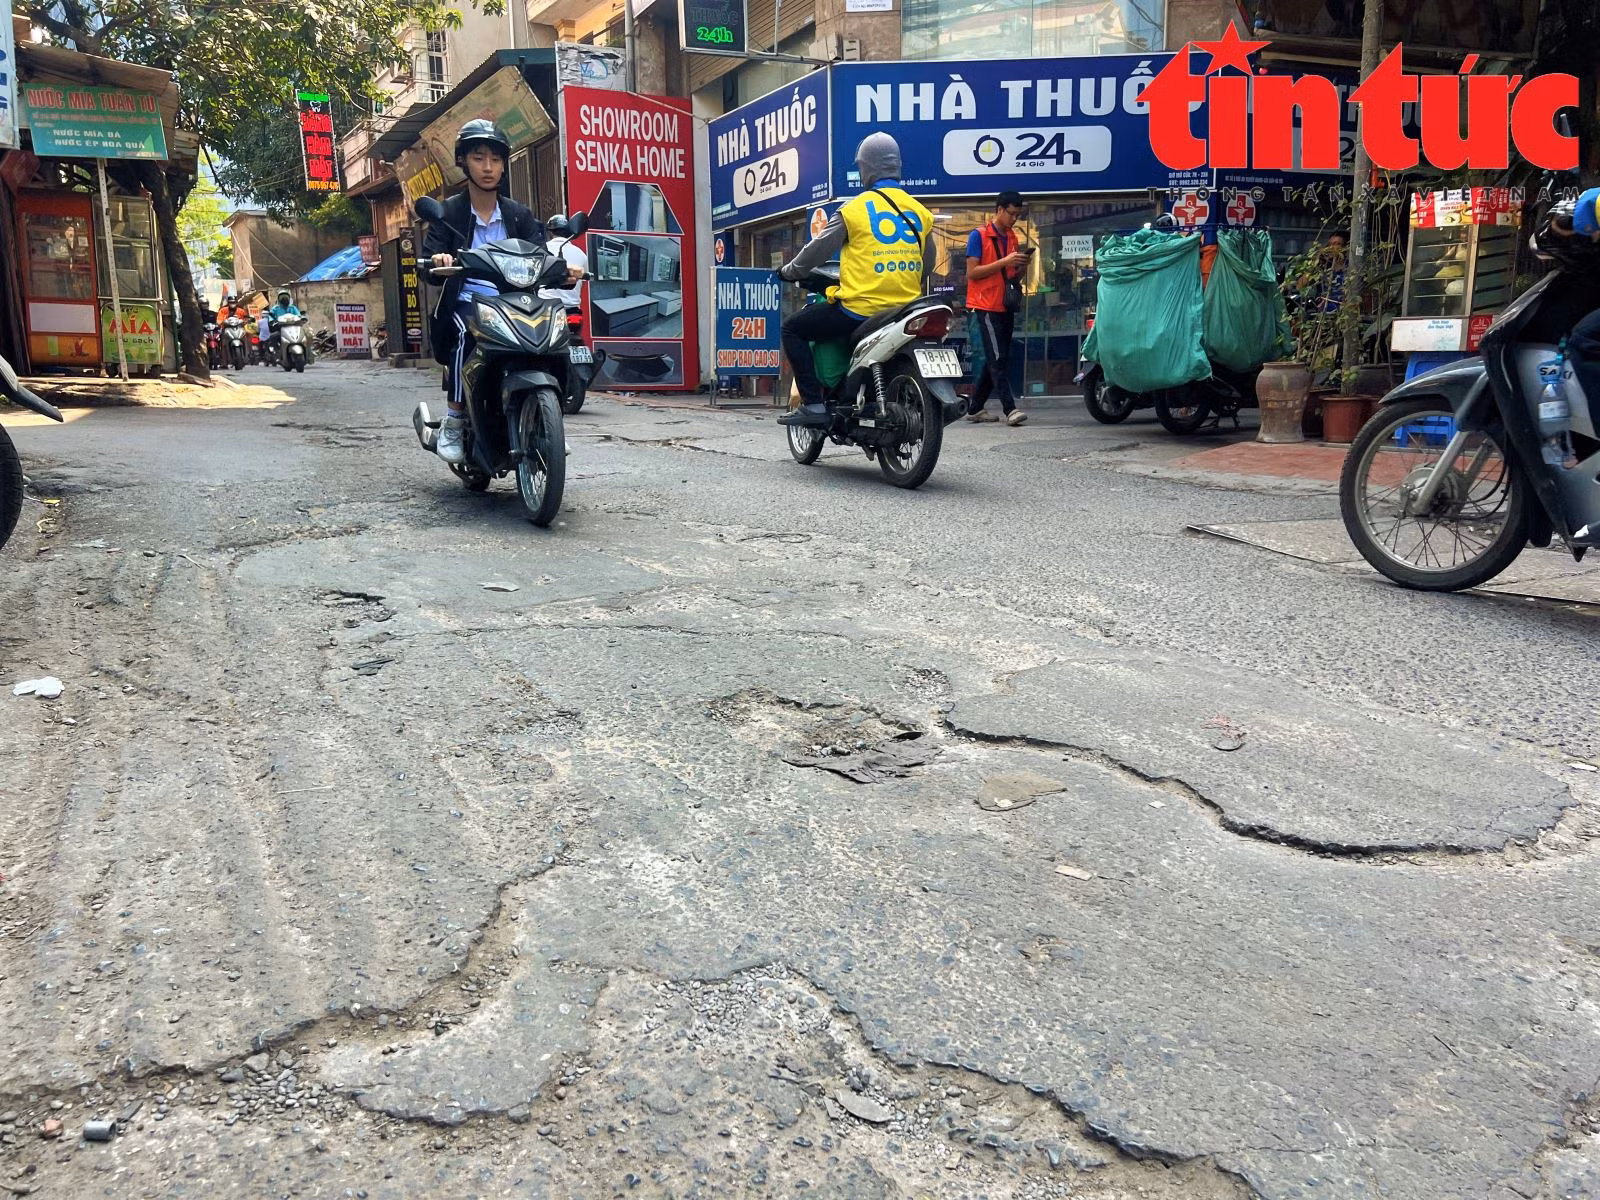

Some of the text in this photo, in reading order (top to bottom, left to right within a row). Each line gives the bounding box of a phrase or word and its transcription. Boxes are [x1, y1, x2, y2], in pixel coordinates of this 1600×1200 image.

[697, 26, 733, 43] 24h
[26, 87, 65, 109] NƯỚC
[856, 61, 1207, 122] NHÀ THUỐ
[53, 128, 81, 137] NƯỚC
[579, 104, 679, 143] SHOWROOM
[717, 87, 816, 167] NHÀ THUỐC
[55, 138, 83, 148] NƯỚC
[1015, 132, 1081, 165] 24h
[575, 139, 686, 179] SENKA HOME
[760, 157, 787, 188] 24h
[865, 201, 923, 245] be
[718, 274, 779, 311] NHÀ THUỐC
[338, 313, 364, 322] RĂNG
[732, 317, 766, 339] 24H
[341, 324, 363, 335] HÀM
[343, 336, 363, 348] MẶT
[717, 349, 780, 367] SHOP BAO CAO SU
[921, 351, 951, 363] 18-H1
